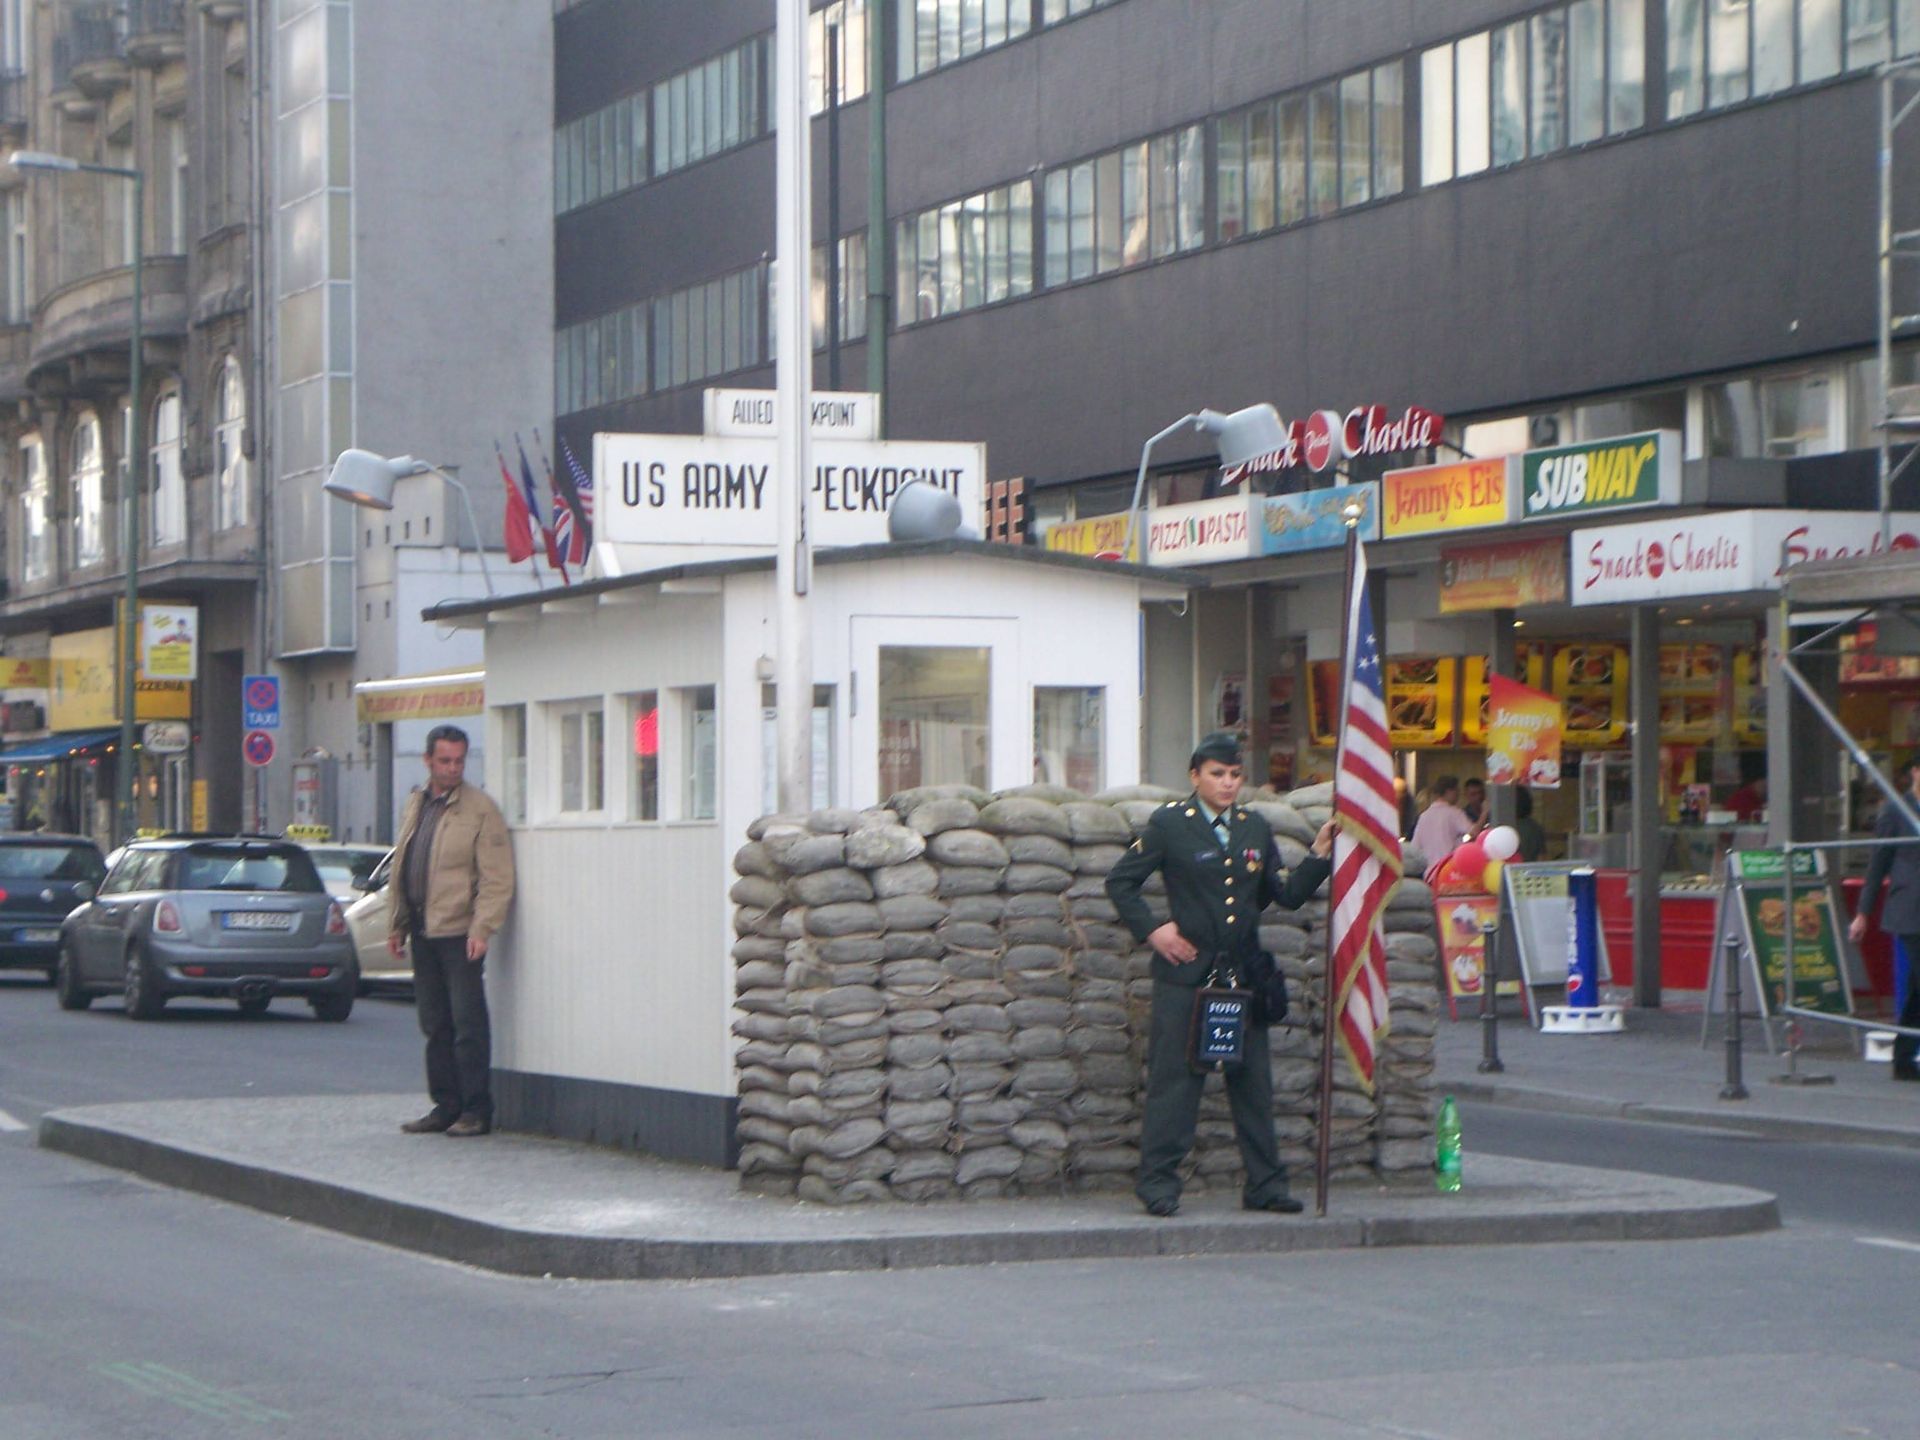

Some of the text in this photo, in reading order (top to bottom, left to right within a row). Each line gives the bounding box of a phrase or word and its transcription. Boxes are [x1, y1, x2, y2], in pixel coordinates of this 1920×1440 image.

[732, 399, 856, 427] ALLIED KPOINT
[1344, 404, 1433, 459] Charlie
[622, 461, 963, 512] US ARMY ECKPT
[1469, 464, 1503, 508] Eis
[1528, 438, 1657, 513] SUBWAY
[1150, 515, 1187, 553] PIZZA
[1206, 511, 1248, 546] PASTA
[1584, 531, 1739, 590] Snack Charlie
[136, 680, 184, 691] ZZERIA
[247, 712, 279, 726] TAXI
